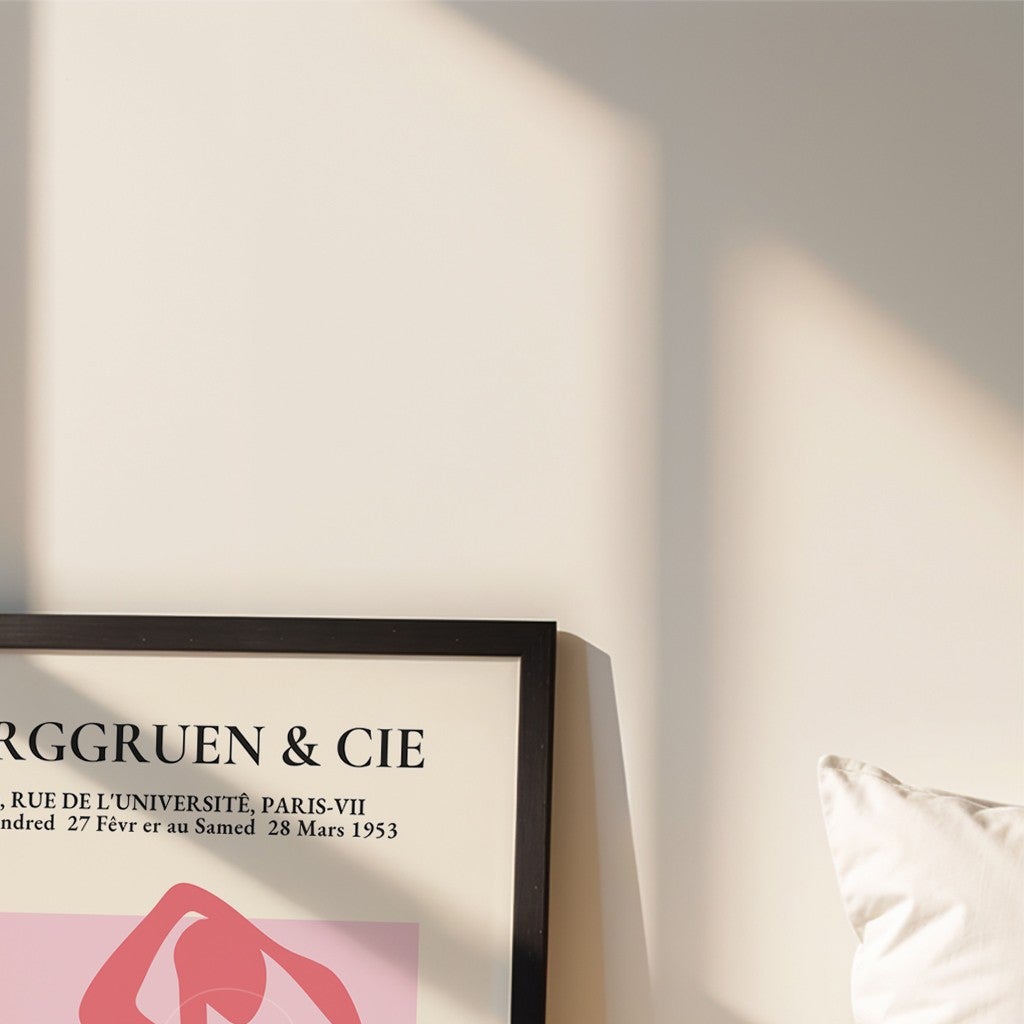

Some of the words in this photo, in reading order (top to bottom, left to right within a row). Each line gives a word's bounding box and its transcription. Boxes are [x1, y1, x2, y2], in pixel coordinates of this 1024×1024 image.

[281, 725, 322, 767] &
[336, 727, 426, 769] CIE
[10, 791, 57, 810] RUE
[61, 792, 92, 811] DE
[260, 796, 367, 816] PARIS-VII
[67, 815, 92, 832] 27
[167, 821, 190, 834] au
[194, 817, 257, 836] Samed
[267, 819, 292, 837] 28
[296, 819, 345, 838] Mars
[352, 821, 399, 840] 1953
